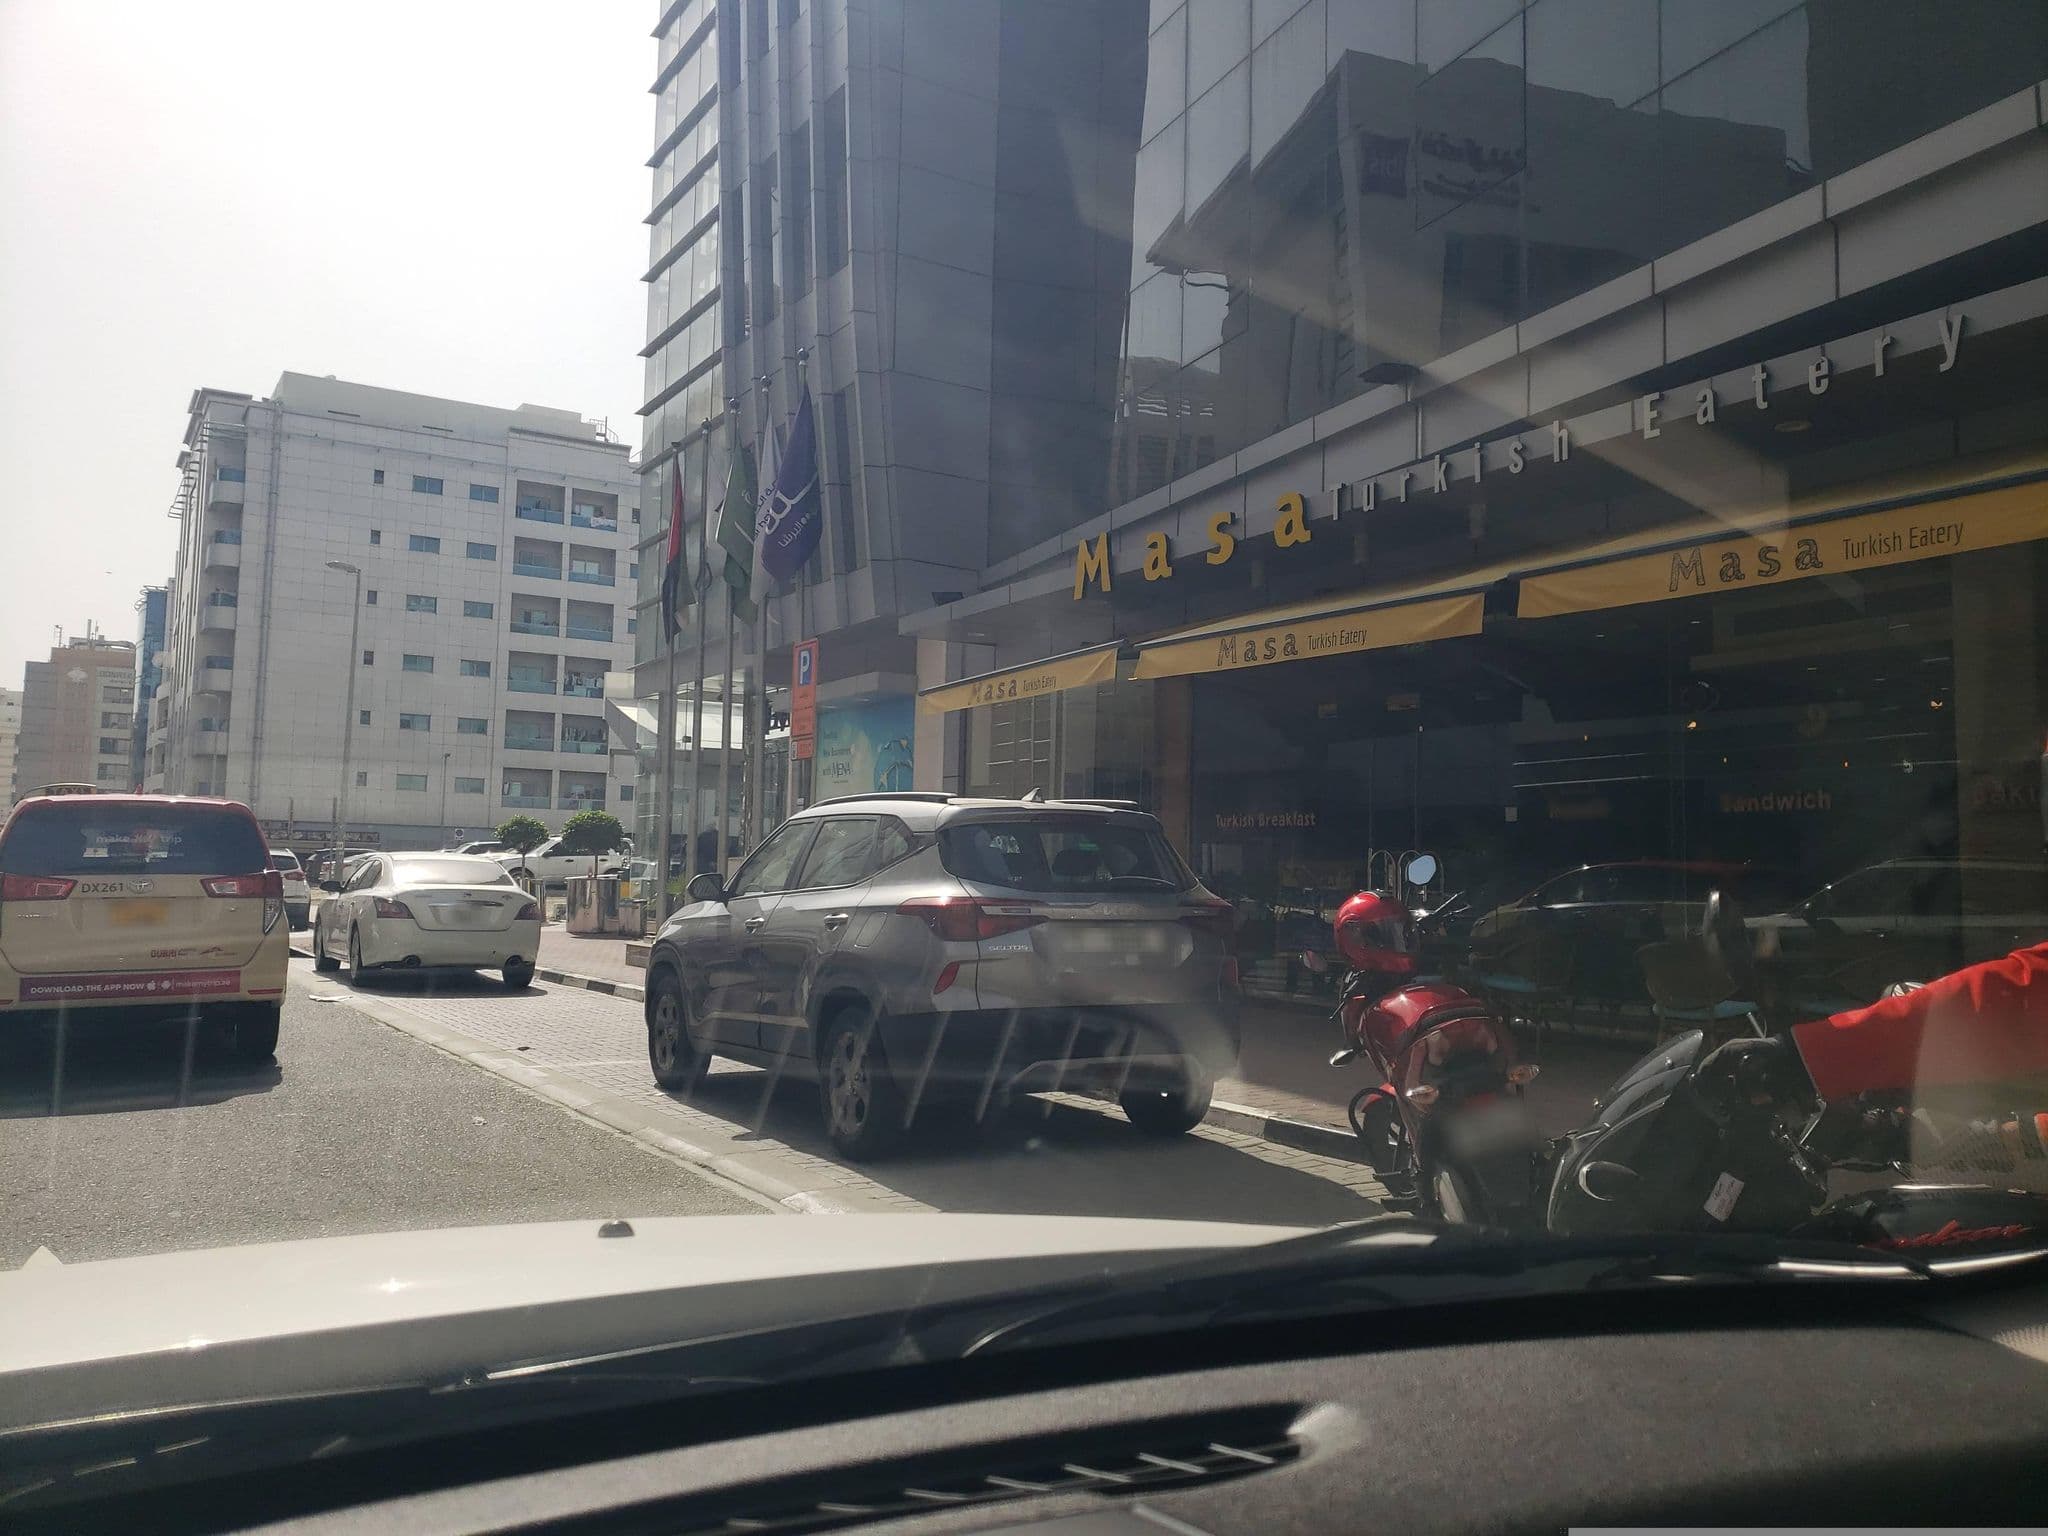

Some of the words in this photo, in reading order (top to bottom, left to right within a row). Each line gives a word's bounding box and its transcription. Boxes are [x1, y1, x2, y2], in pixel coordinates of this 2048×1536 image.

[1073, 491, 1312, 600] Masa
[1330, 420, 1569, 521] Turkish
[1642, 314, 1967, 440] Eatery
[1669, 538, 1824, 592] Masa
[1843, 533, 1902, 560] Turkish
[1909, 521, 1964, 550] Eatery
[1217, 633, 1298, 667] Masa
[1307, 632, 1337, 651] Turkish
[1339, 629, 1368, 646] Eatery
[1216, 813, 1255, 828] Turkish
[1258, 810, 1317, 827] Breakfast
[80, 882, 124, 894] DX261
[30, 984, 84, 995] DOWNLOAD
[85, 983, 102, 992] THE
[102, 982, 122, 992] APP
[122, 981, 145, 991] NOW
